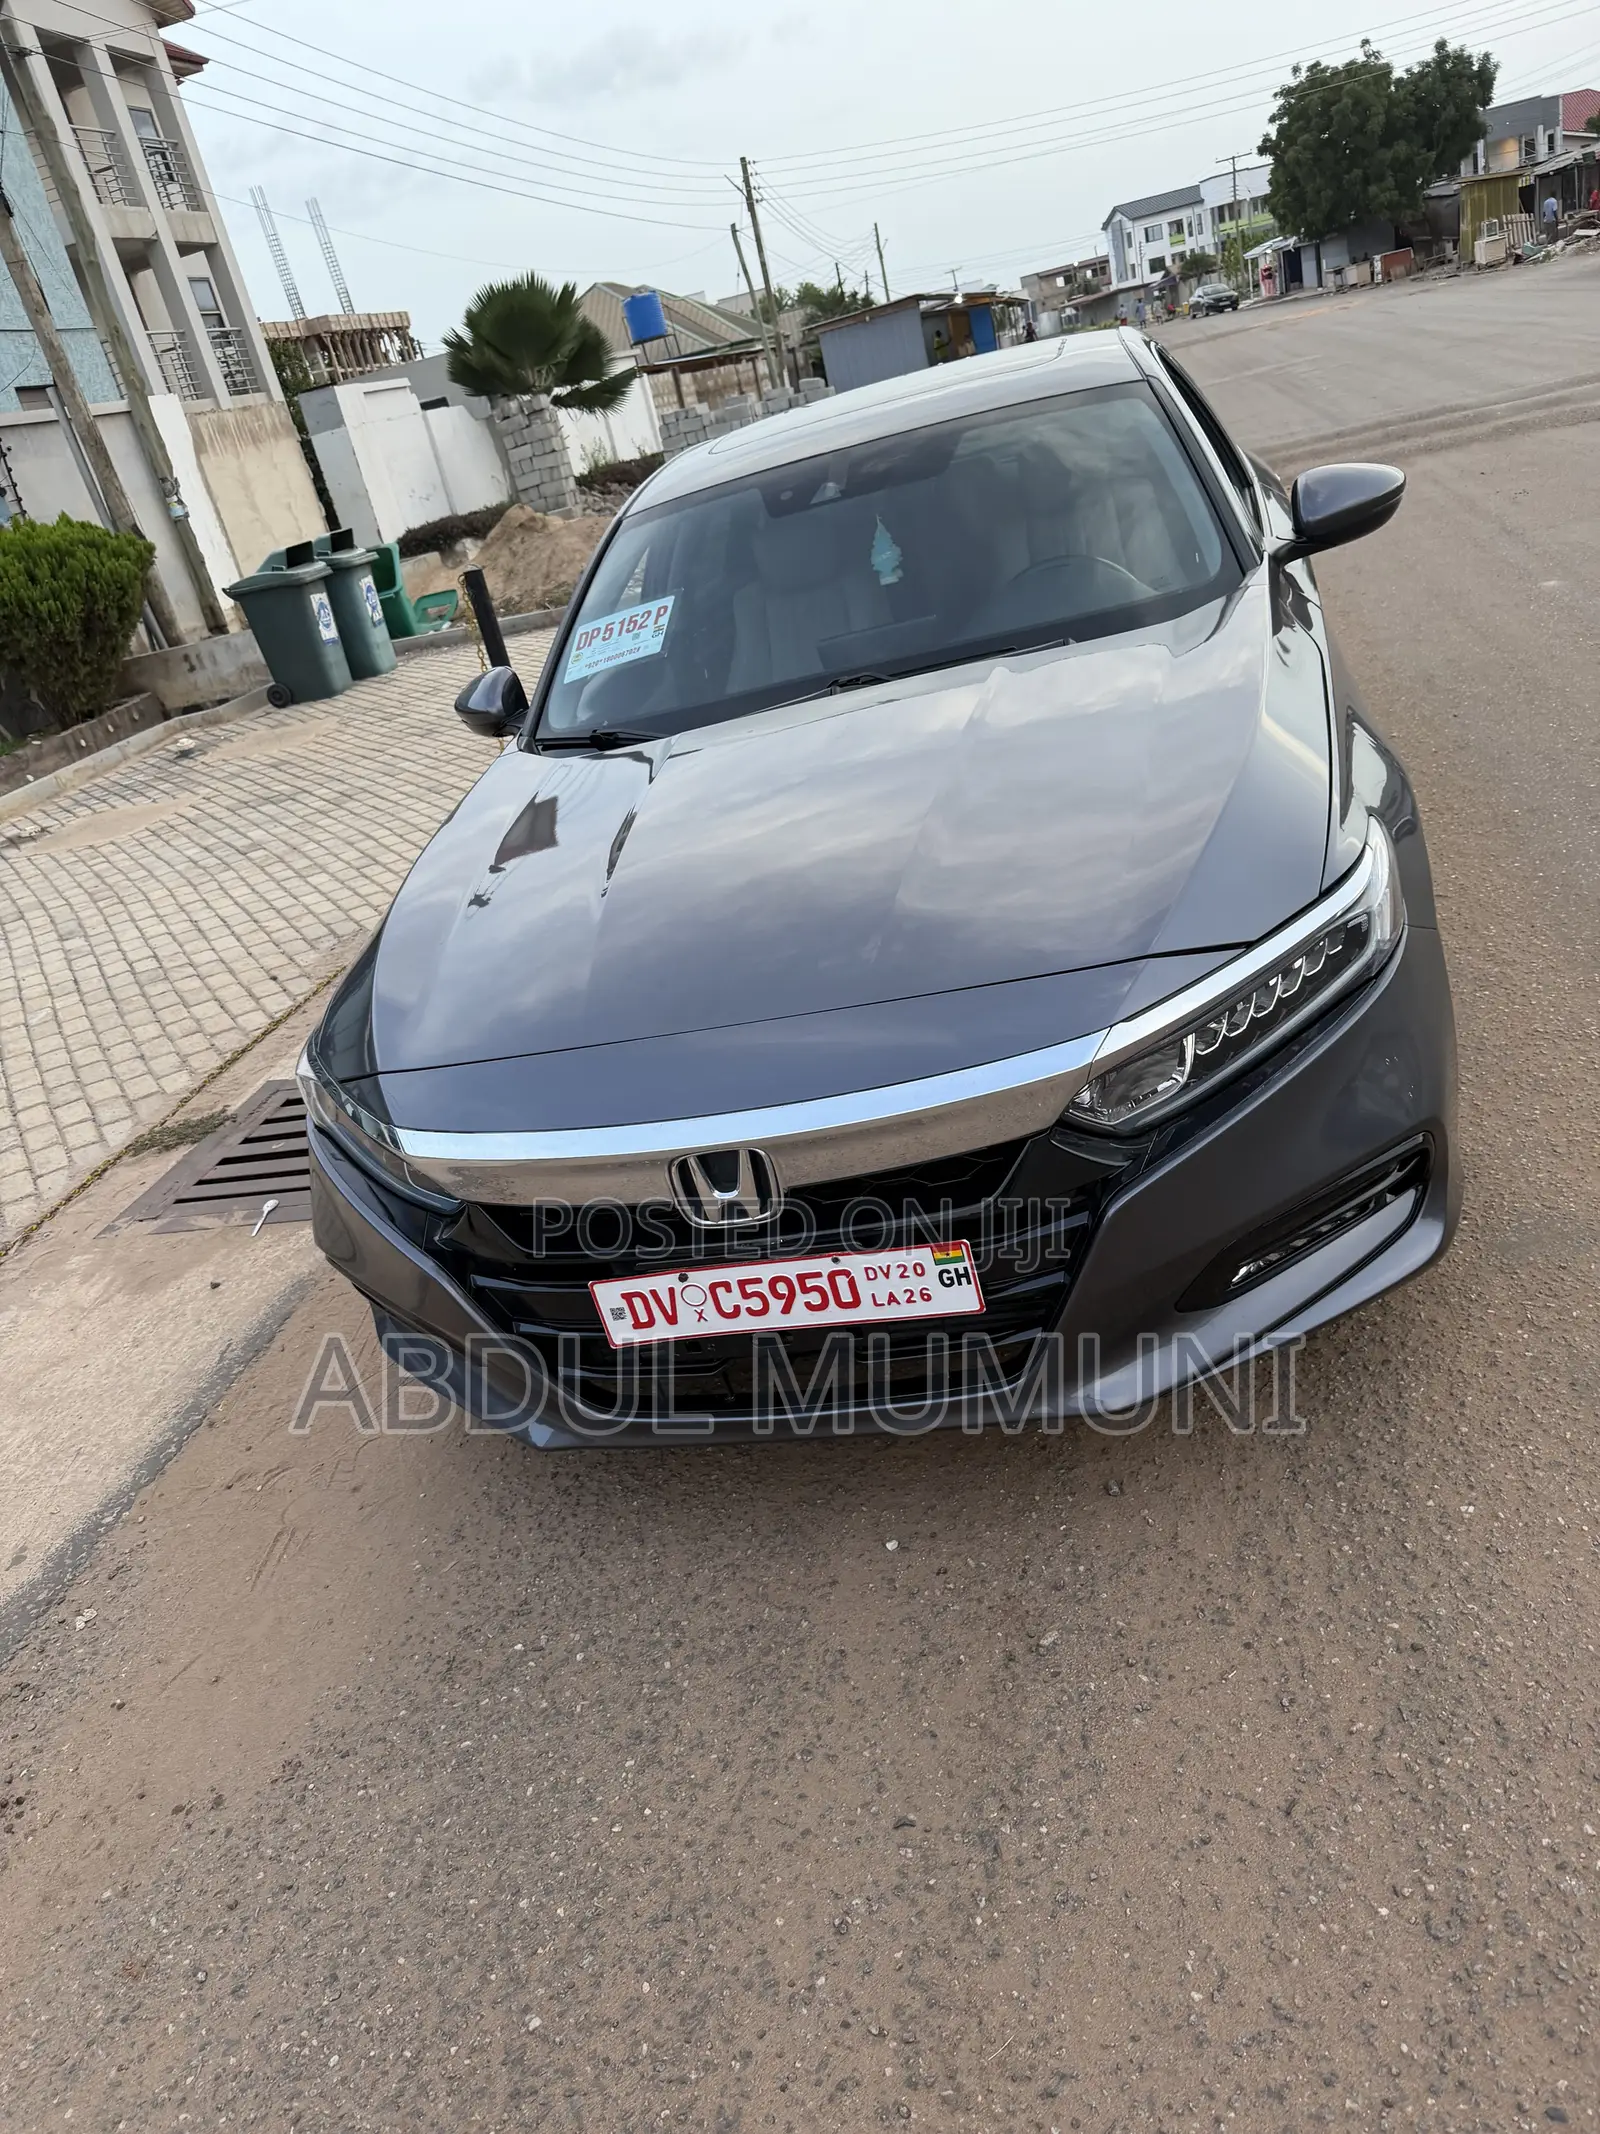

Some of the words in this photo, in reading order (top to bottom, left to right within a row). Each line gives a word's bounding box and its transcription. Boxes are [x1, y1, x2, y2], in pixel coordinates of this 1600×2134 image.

[575, 626, 602, 652] DP
[653, 604, 669, 626] P
[620, 1286, 679, 1330] DV
[708, 1268, 862, 1320] C5950
[938, 1266, 973, 1288] GH
